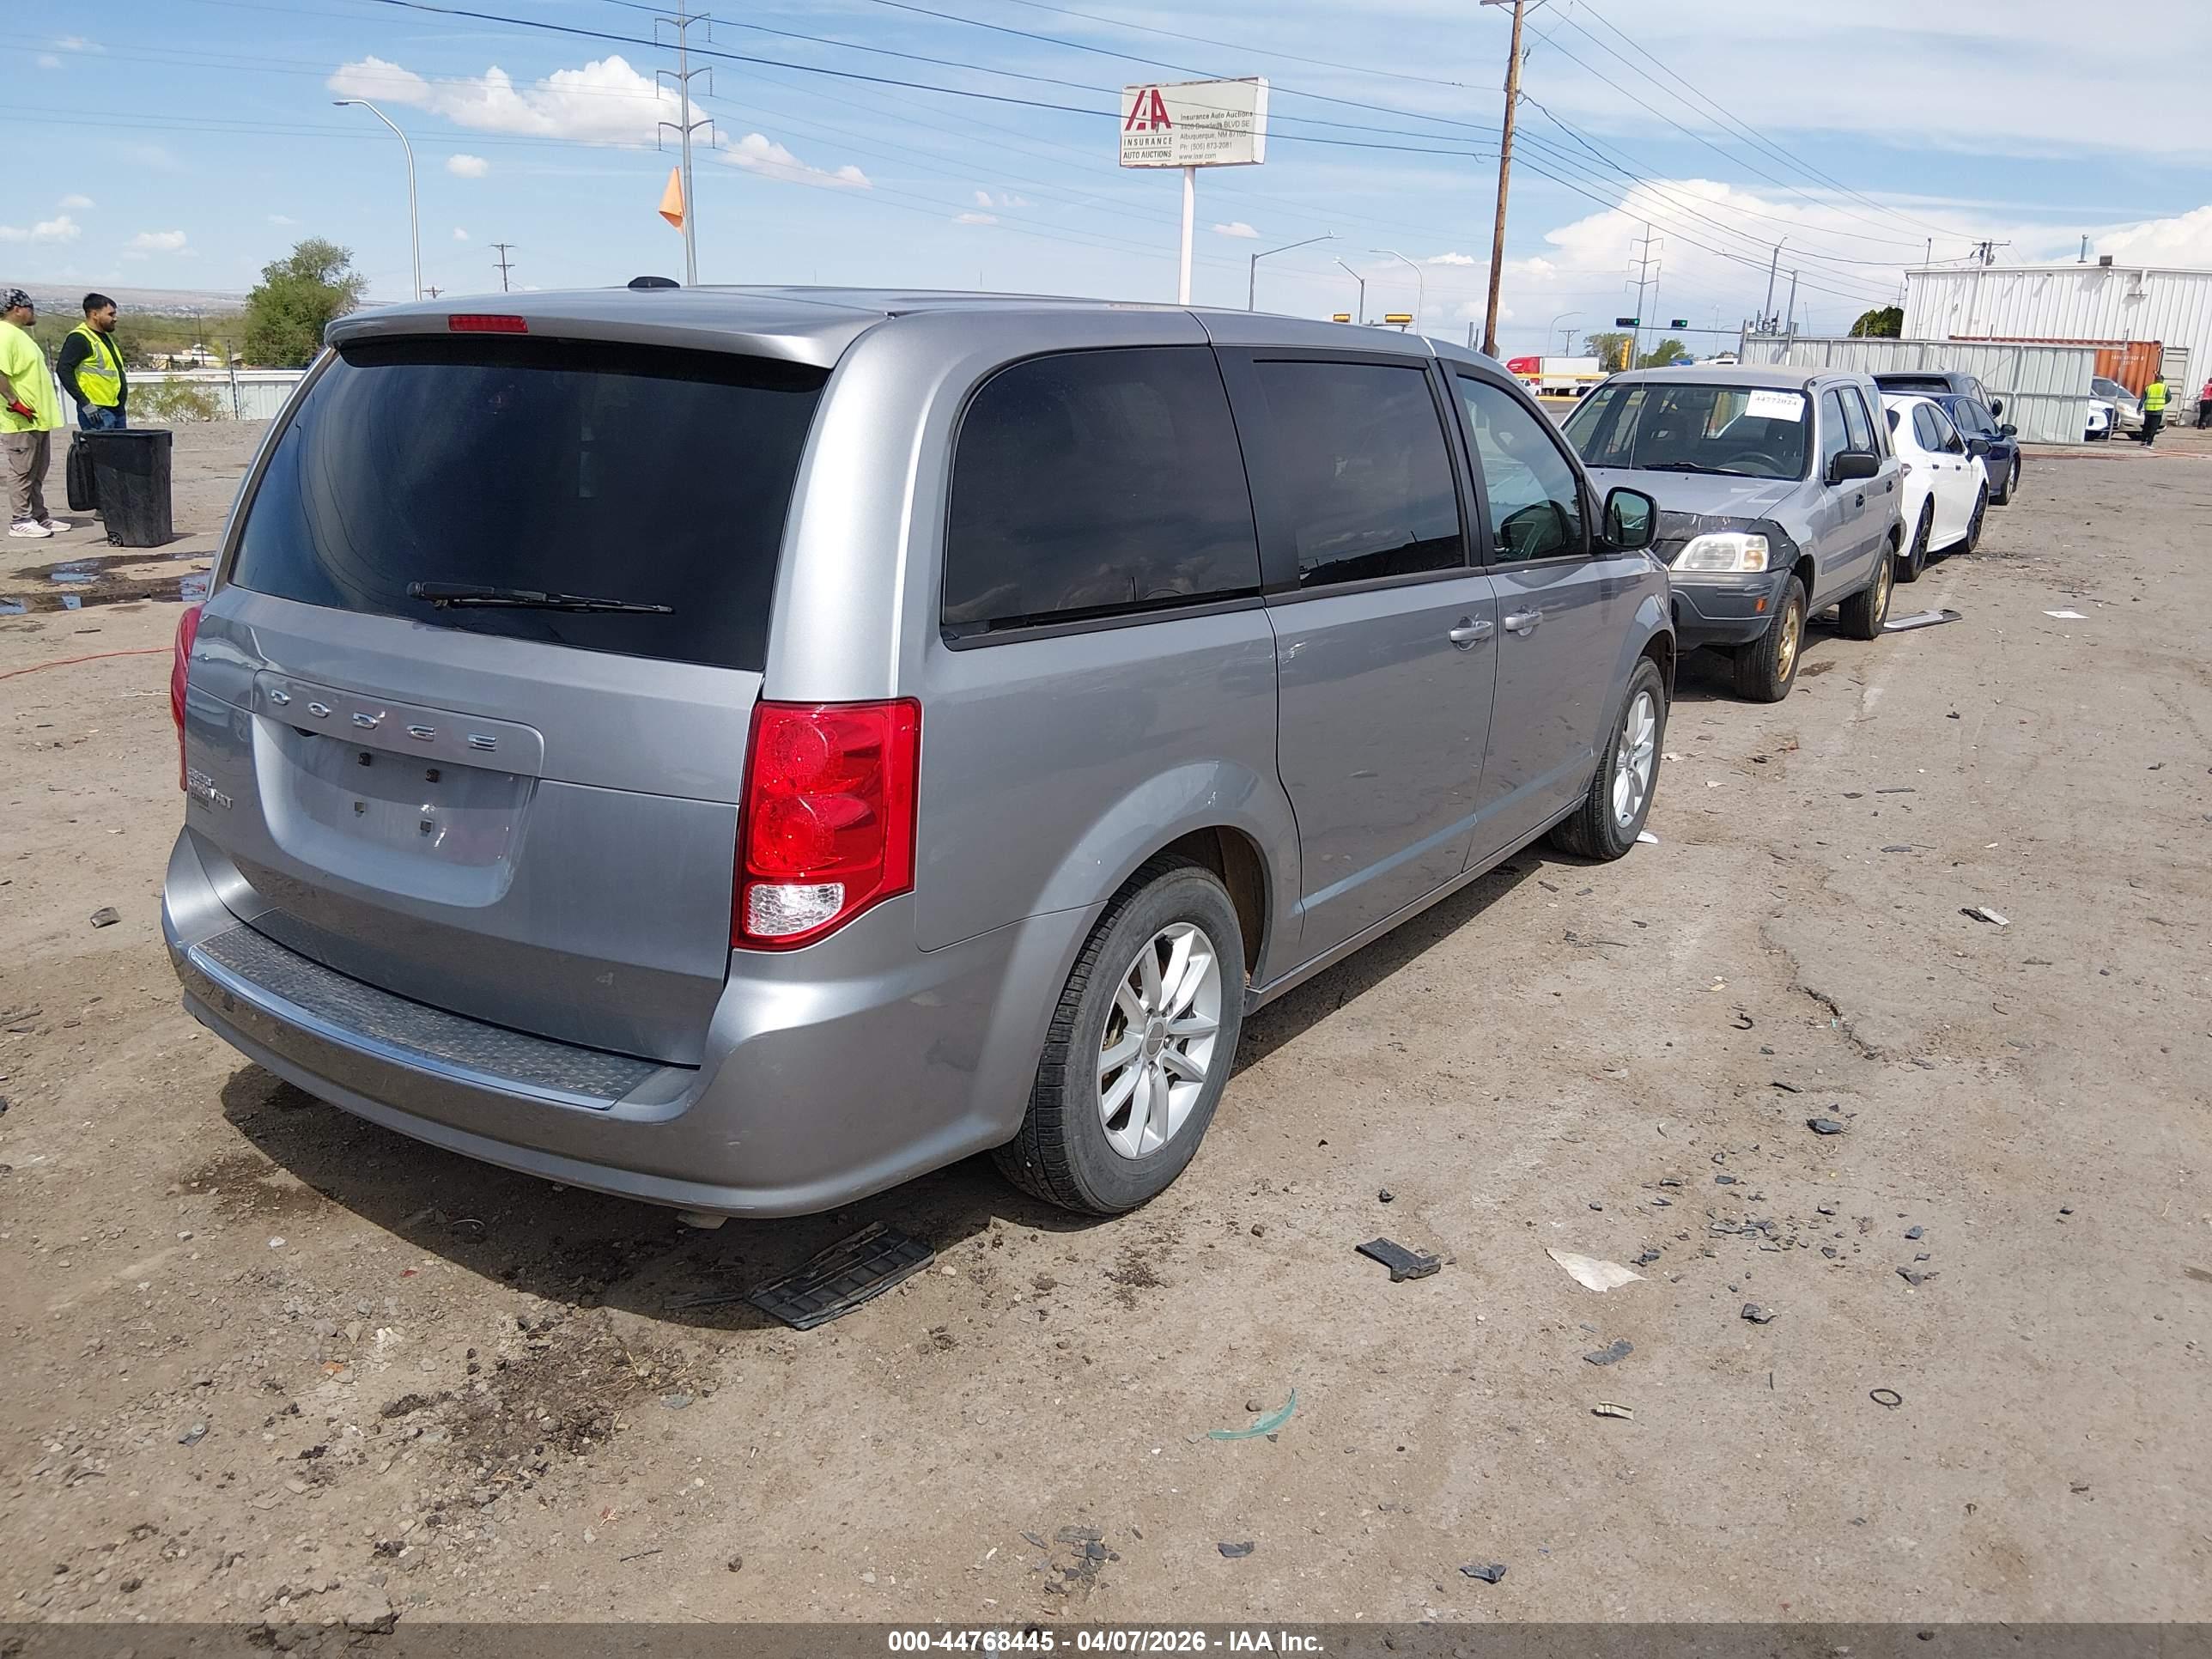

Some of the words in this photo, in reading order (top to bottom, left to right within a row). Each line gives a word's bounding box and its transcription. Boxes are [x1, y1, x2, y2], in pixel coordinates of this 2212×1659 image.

[1124, 137, 1172, 146] INSURANCE
[1141, 149, 1172, 158] AUCTIONS
[270, 689, 496, 751] DODGE
